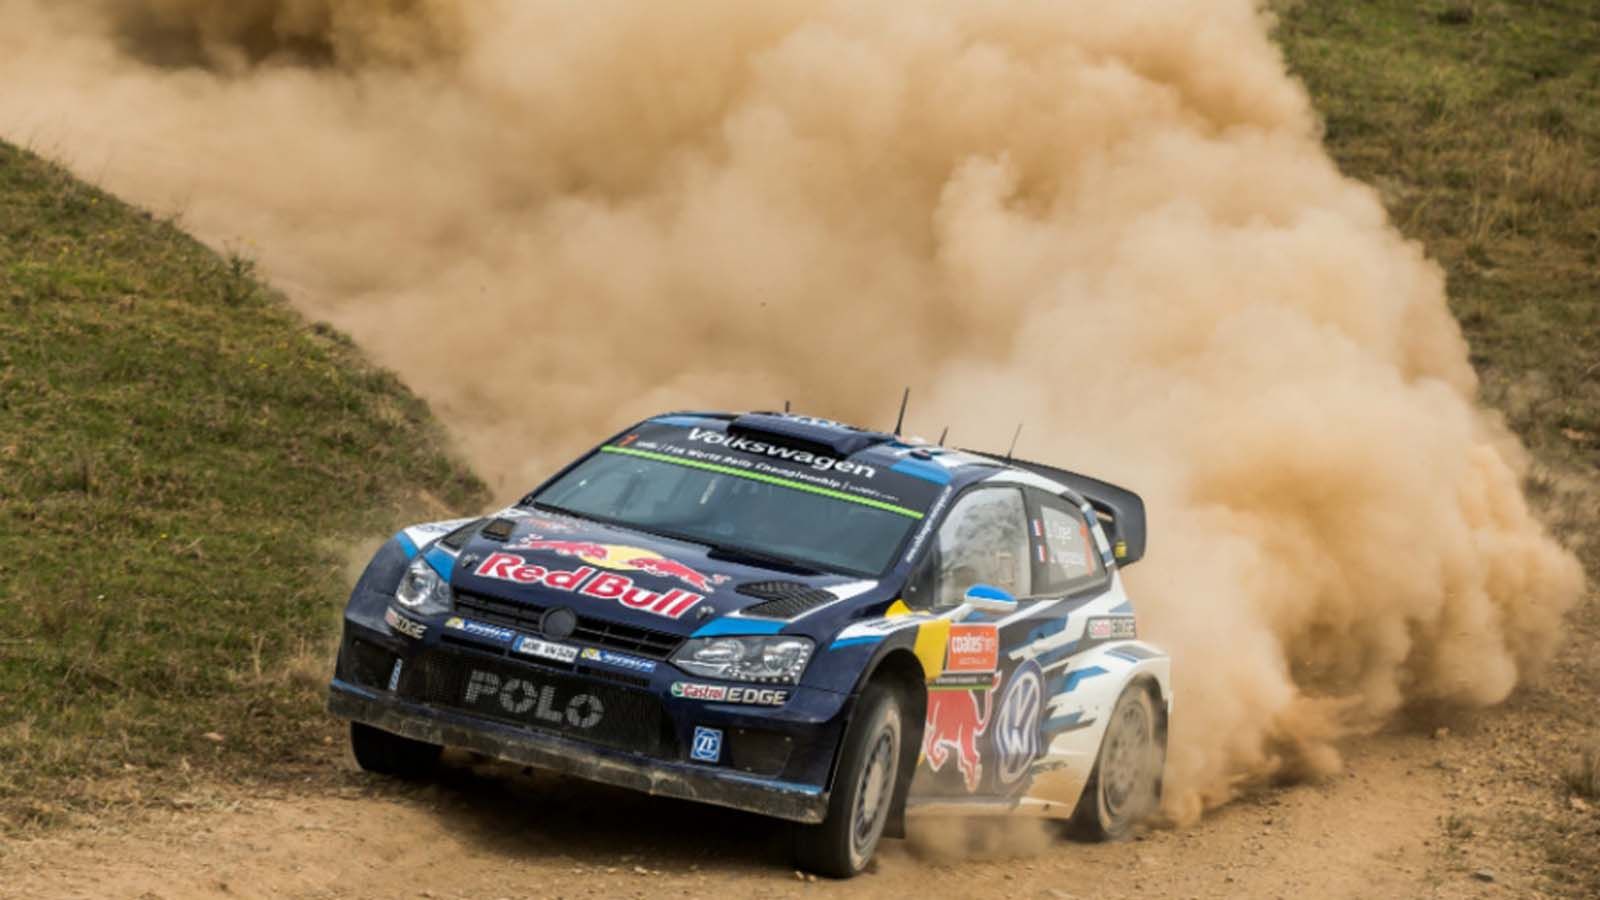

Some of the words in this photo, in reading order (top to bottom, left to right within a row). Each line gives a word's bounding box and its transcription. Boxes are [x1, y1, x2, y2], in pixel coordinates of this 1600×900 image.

[687, 427, 876, 479] Volkswagen
[474, 552, 594, 592] Red
[581, 570, 705, 621] Bull
[465, 668, 606, 730] POLO
[683, 683, 725, 702] Castrol
[726, 686, 787, 706] EDGE
[699, 735, 714, 754] ZF
